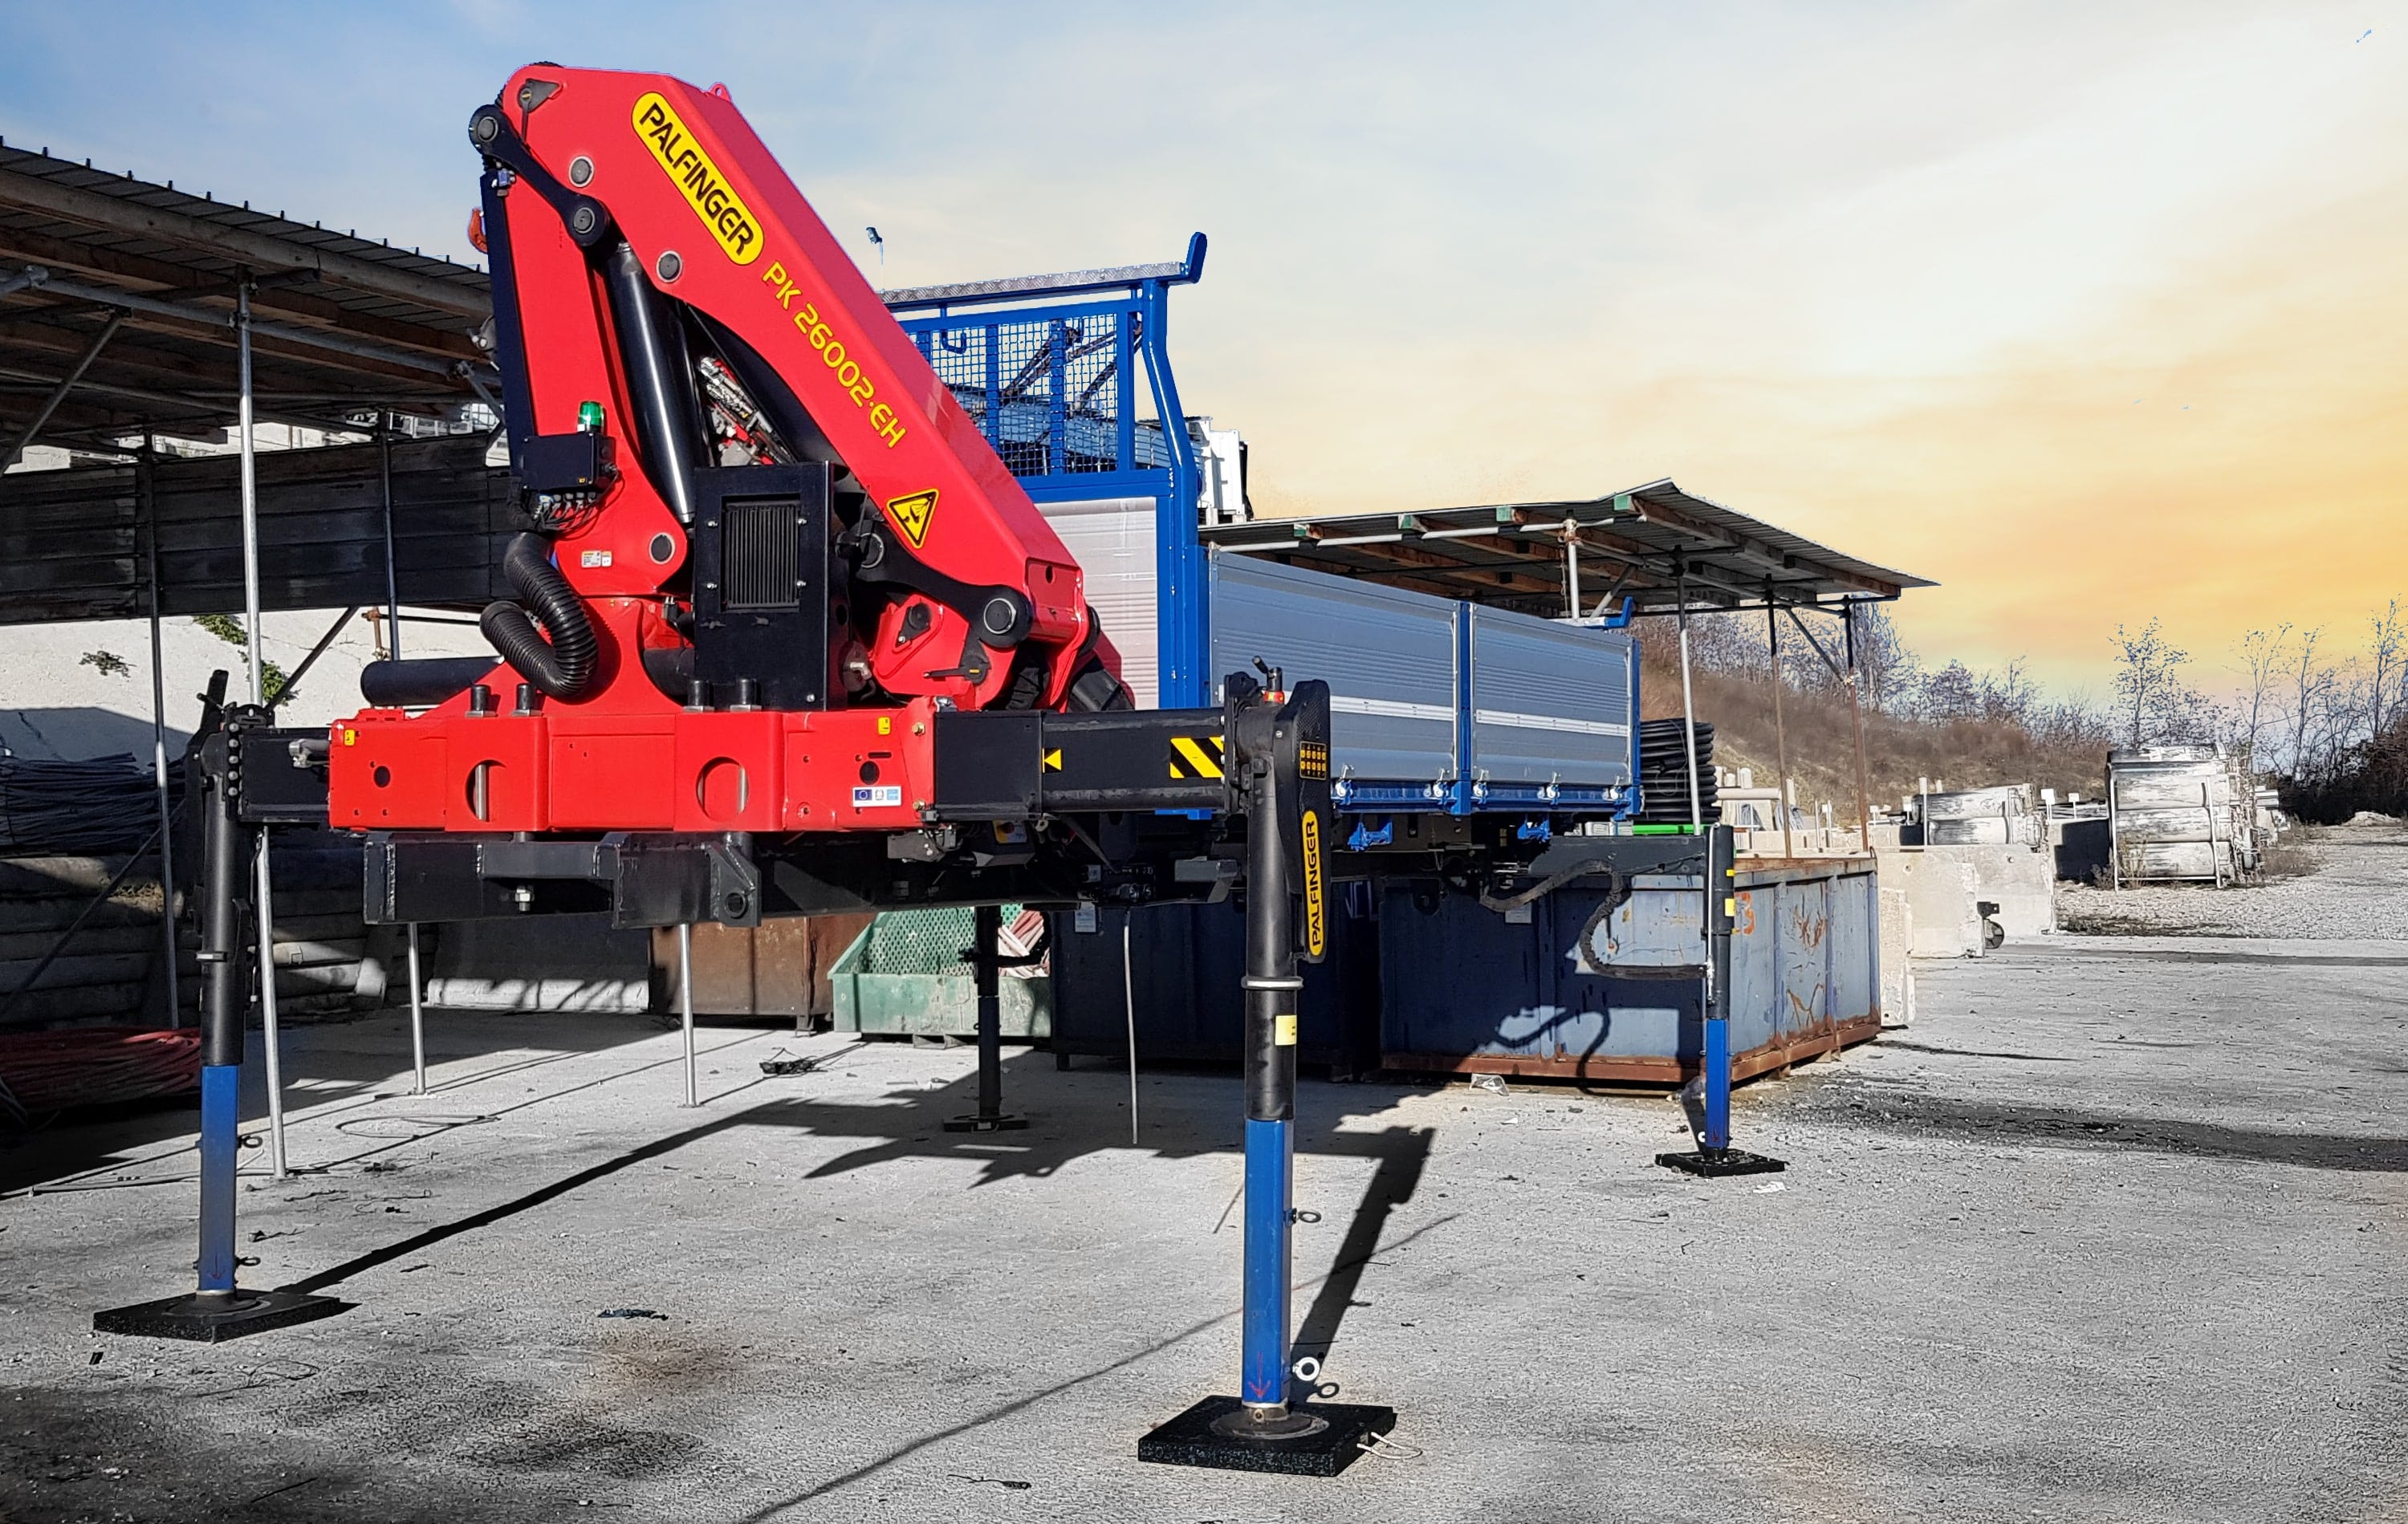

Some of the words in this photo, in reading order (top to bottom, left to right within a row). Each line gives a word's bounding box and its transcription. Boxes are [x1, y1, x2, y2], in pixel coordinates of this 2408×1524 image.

[639, 102, 754, 256] PALFINGER
[763, 261, 802, 311] PK
[1306, 820, 1322, 946] PALFINGER
